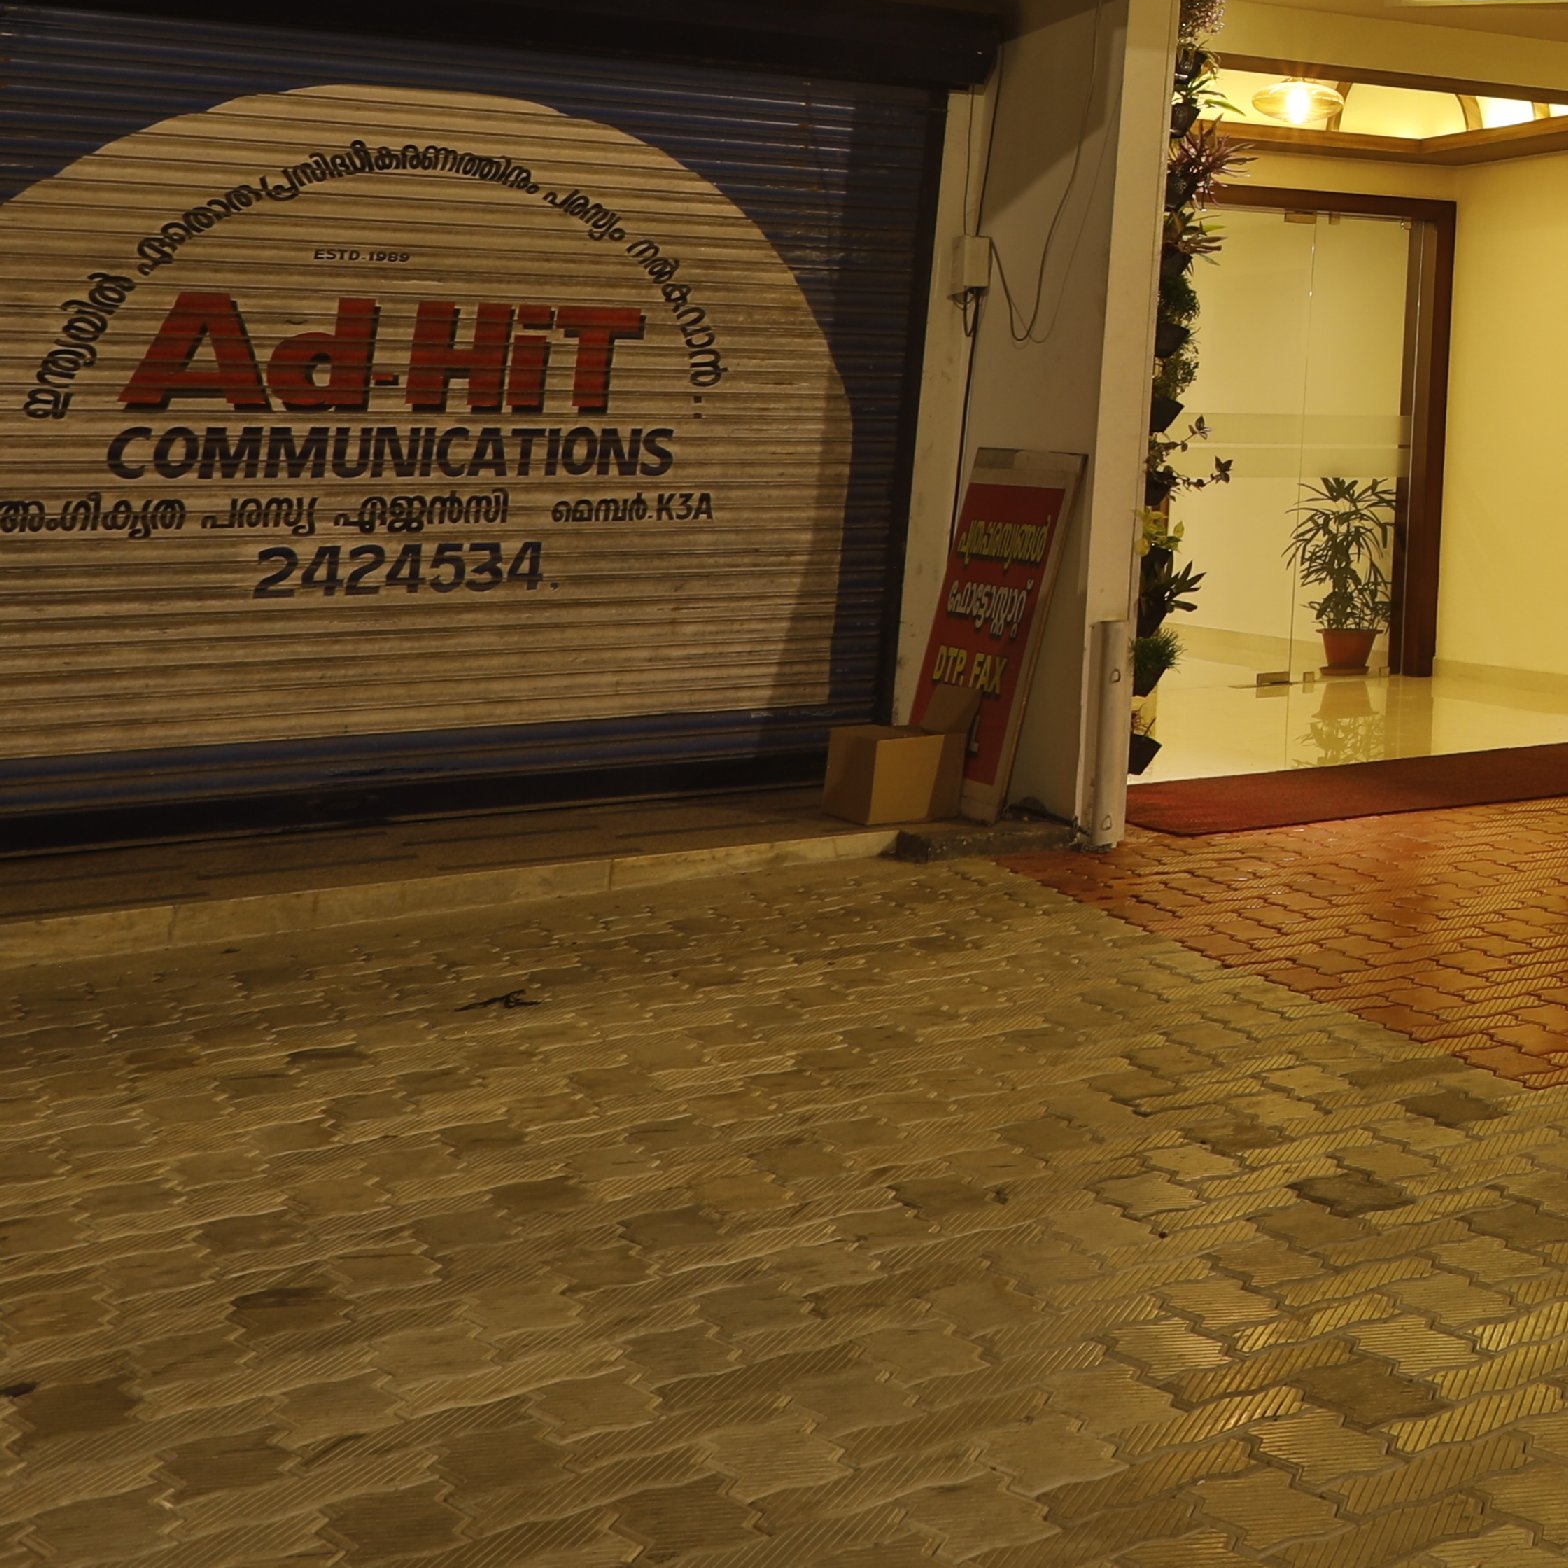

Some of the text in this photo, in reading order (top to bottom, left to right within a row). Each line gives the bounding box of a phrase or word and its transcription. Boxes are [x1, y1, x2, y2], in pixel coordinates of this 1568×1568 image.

[107, 427, 674, 480] COMMUNICATIONS
[201, 496, 318, 537] പരസ്യ
[969, 653, 1008, 695] FAX
